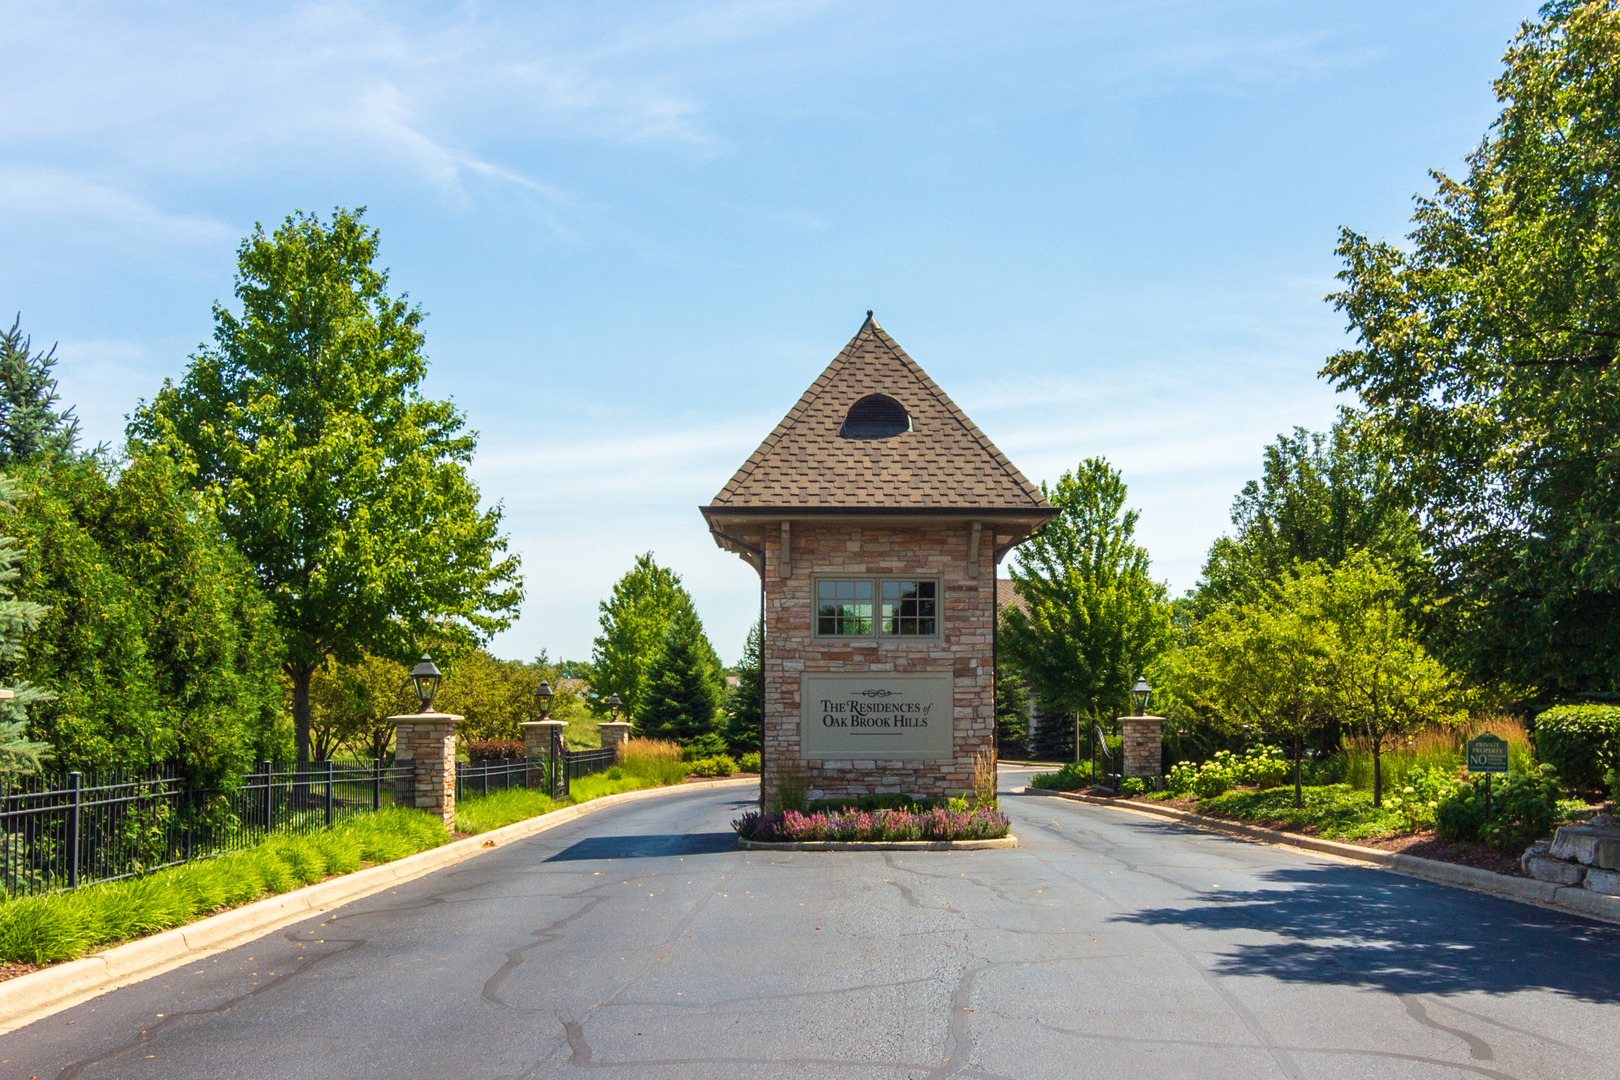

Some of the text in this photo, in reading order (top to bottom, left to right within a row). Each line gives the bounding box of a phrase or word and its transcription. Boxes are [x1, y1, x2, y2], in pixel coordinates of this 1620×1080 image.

[820, 699, 934, 717] THE RESIDENCES of
[822, 714, 928, 728] OAK BROOK HILLS
[1470, 754, 1487, 765] NO
